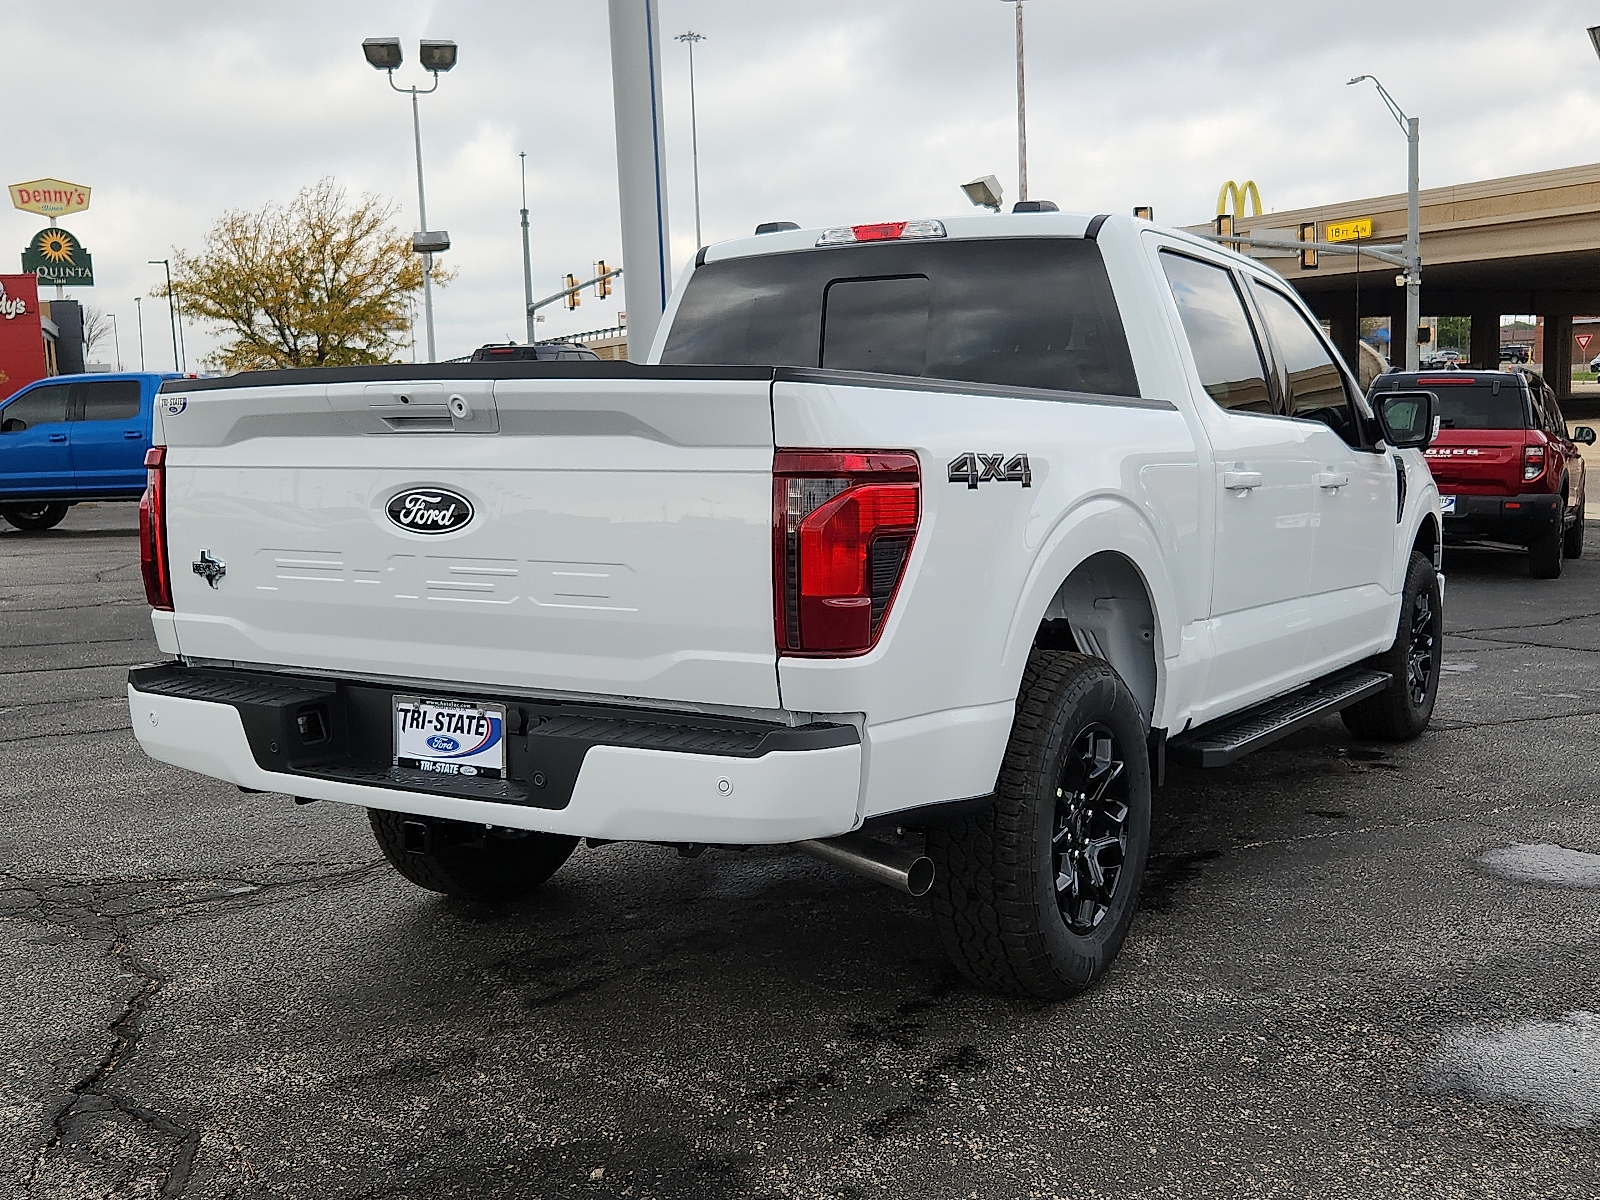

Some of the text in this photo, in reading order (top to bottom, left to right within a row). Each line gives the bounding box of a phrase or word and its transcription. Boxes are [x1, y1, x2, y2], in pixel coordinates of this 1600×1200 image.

[17, 188, 85, 206] Denny's
[1352, 224, 1360, 237] 4
[36, 266, 92, 280] QUINTA
[400, 494, 455, 526] Ford
[397, 707, 486, 737] TRI-STATE
[432, 737, 454, 750] Ford
